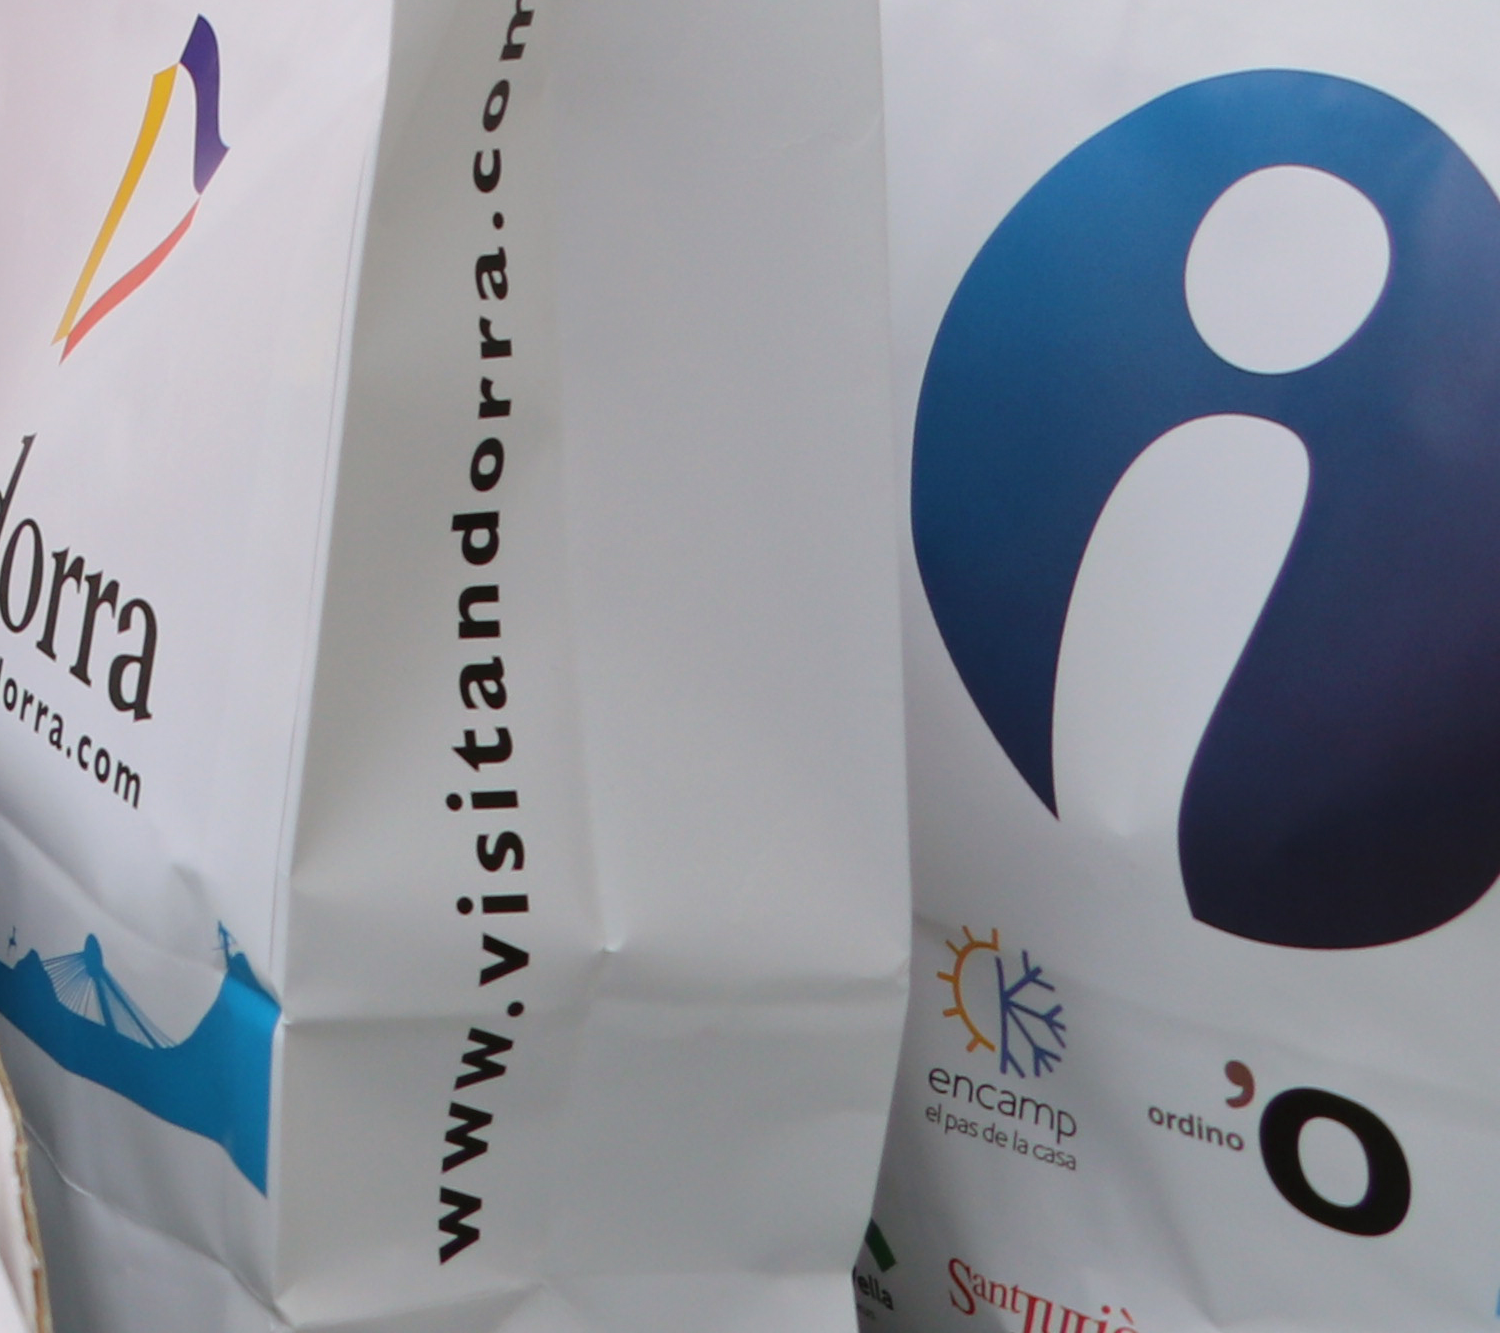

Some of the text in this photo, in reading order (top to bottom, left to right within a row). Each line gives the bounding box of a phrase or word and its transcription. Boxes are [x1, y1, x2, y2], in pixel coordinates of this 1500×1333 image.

[928, 1067, 1077, 1144] encamp
[1148, 1106, 1244, 1151] ordino
[925, 1104, 1077, 1171] el pas de la casa
[852, 1267, 894, 1311] ella
